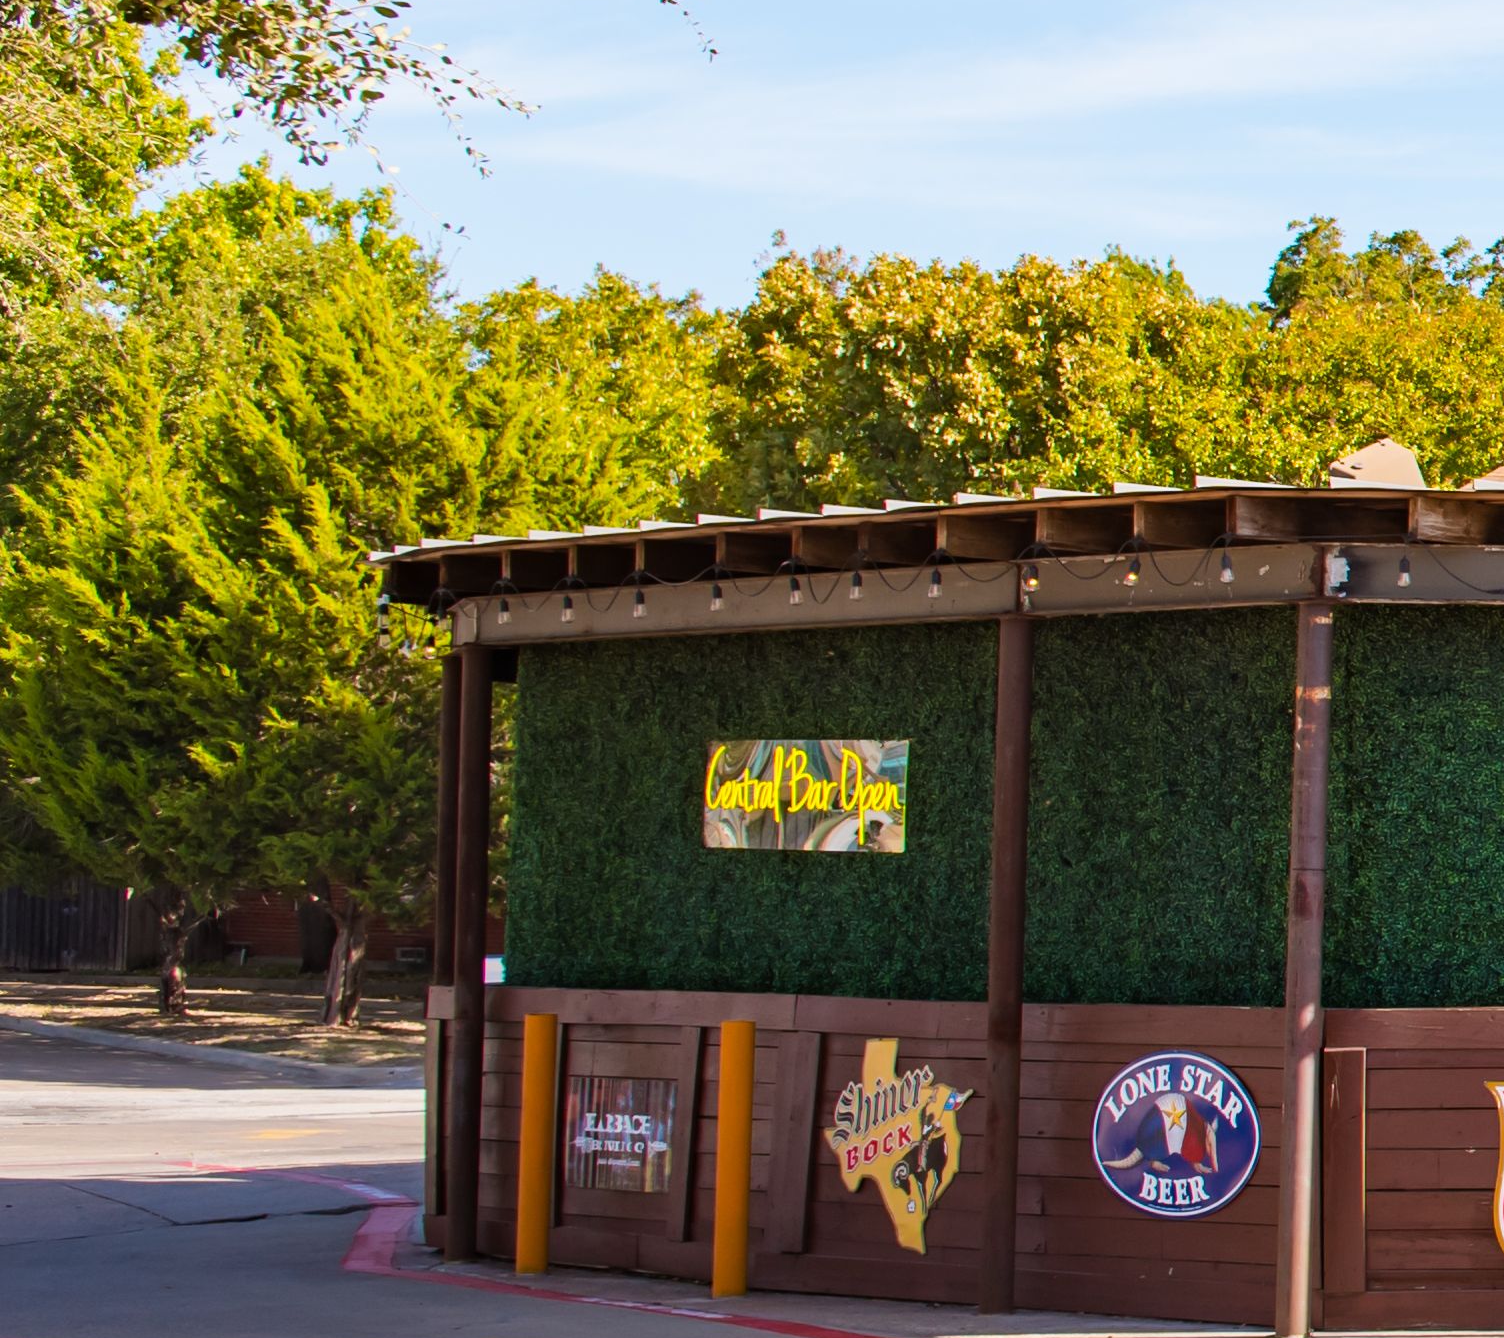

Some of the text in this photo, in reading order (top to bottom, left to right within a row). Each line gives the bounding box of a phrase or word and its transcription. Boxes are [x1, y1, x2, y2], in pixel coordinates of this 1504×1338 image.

[705, 745, 905, 845] Central Bar Open
[832, 1065, 935, 1149] Shiner
[1104, 1064, 1243, 1129] LONE STAR
[846, 1123, 914, 1172] BOCK
[1139, 1172, 1210, 1205] BEER
